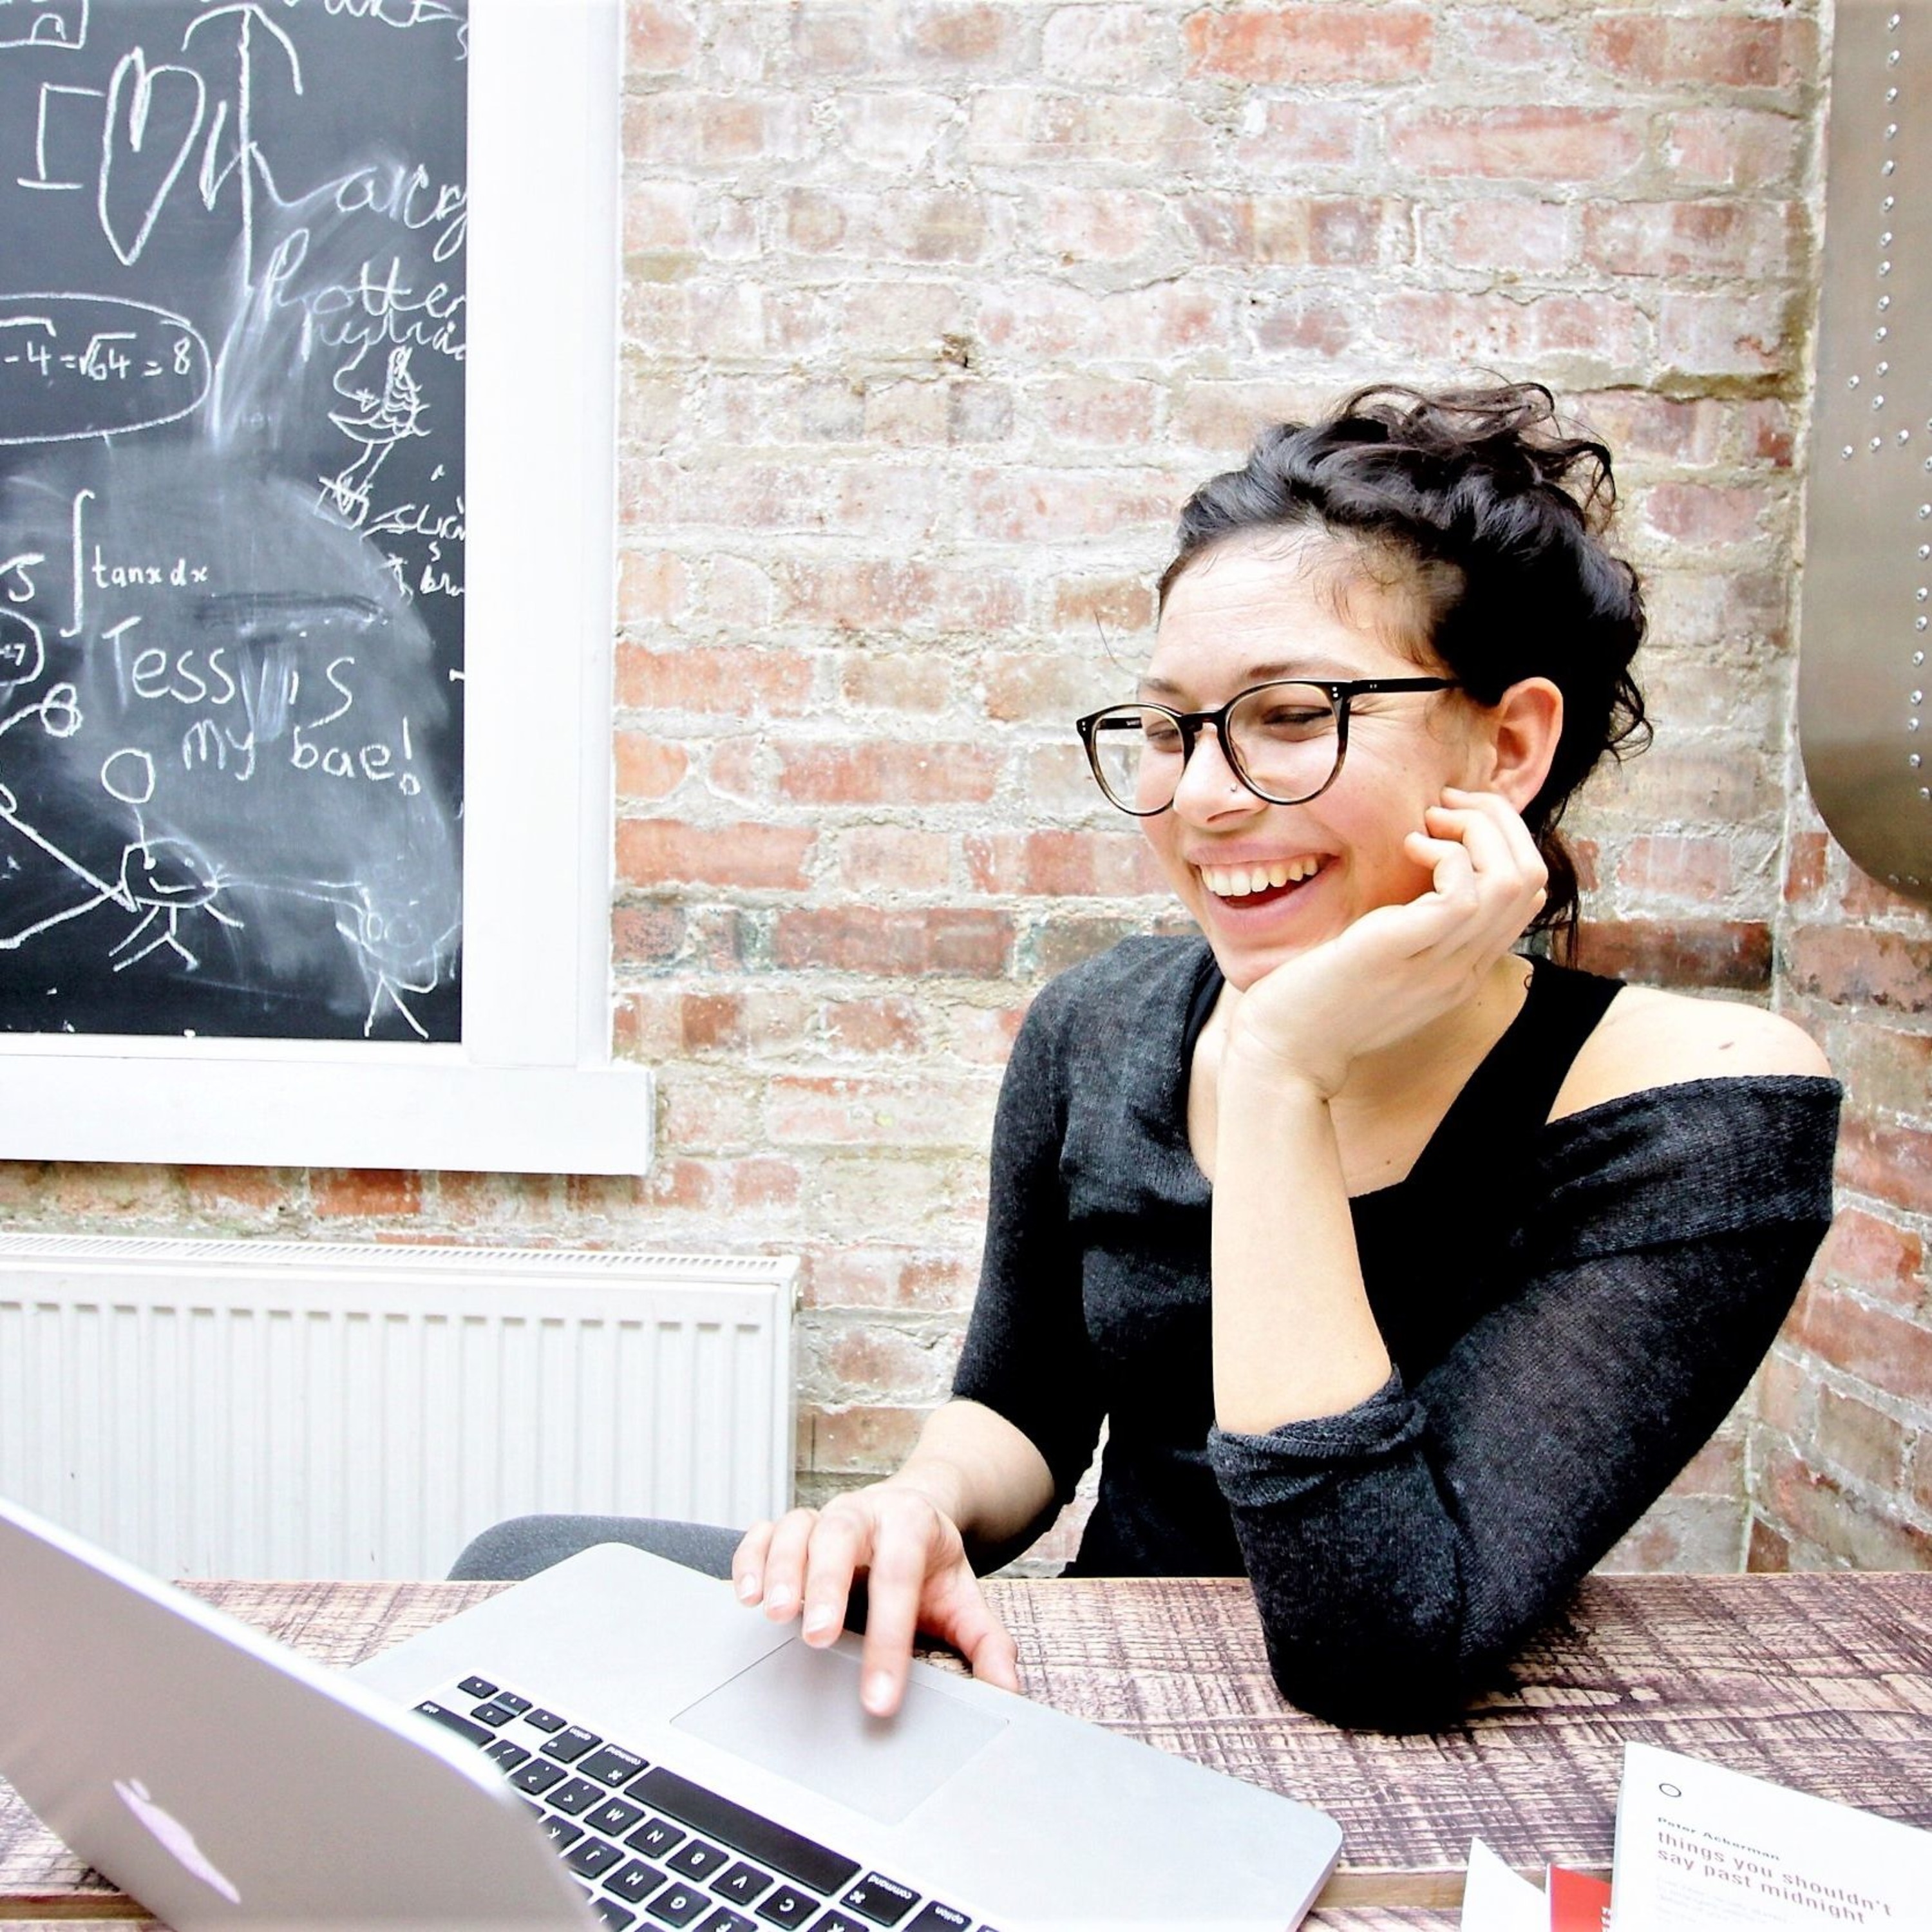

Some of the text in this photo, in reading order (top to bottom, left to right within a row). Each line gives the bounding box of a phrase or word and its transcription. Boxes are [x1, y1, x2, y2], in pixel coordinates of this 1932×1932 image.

[101, 616, 236, 711] Tess
[182, 716, 421, 796] my bae!
[867, 1875, 913, 1900] command
[1657, 1849, 1695, 1871] say
[1703, 1864, 1751, 1888] past
[1760, 1882, 1865, 1925] midnight
[1658, 1831, 1725, 1862] things
[1733, 1857, 1773, 1878] you
[1781, 1872, 1892, 1917] shouldn't
[934, 1905, 964, 1925] option
